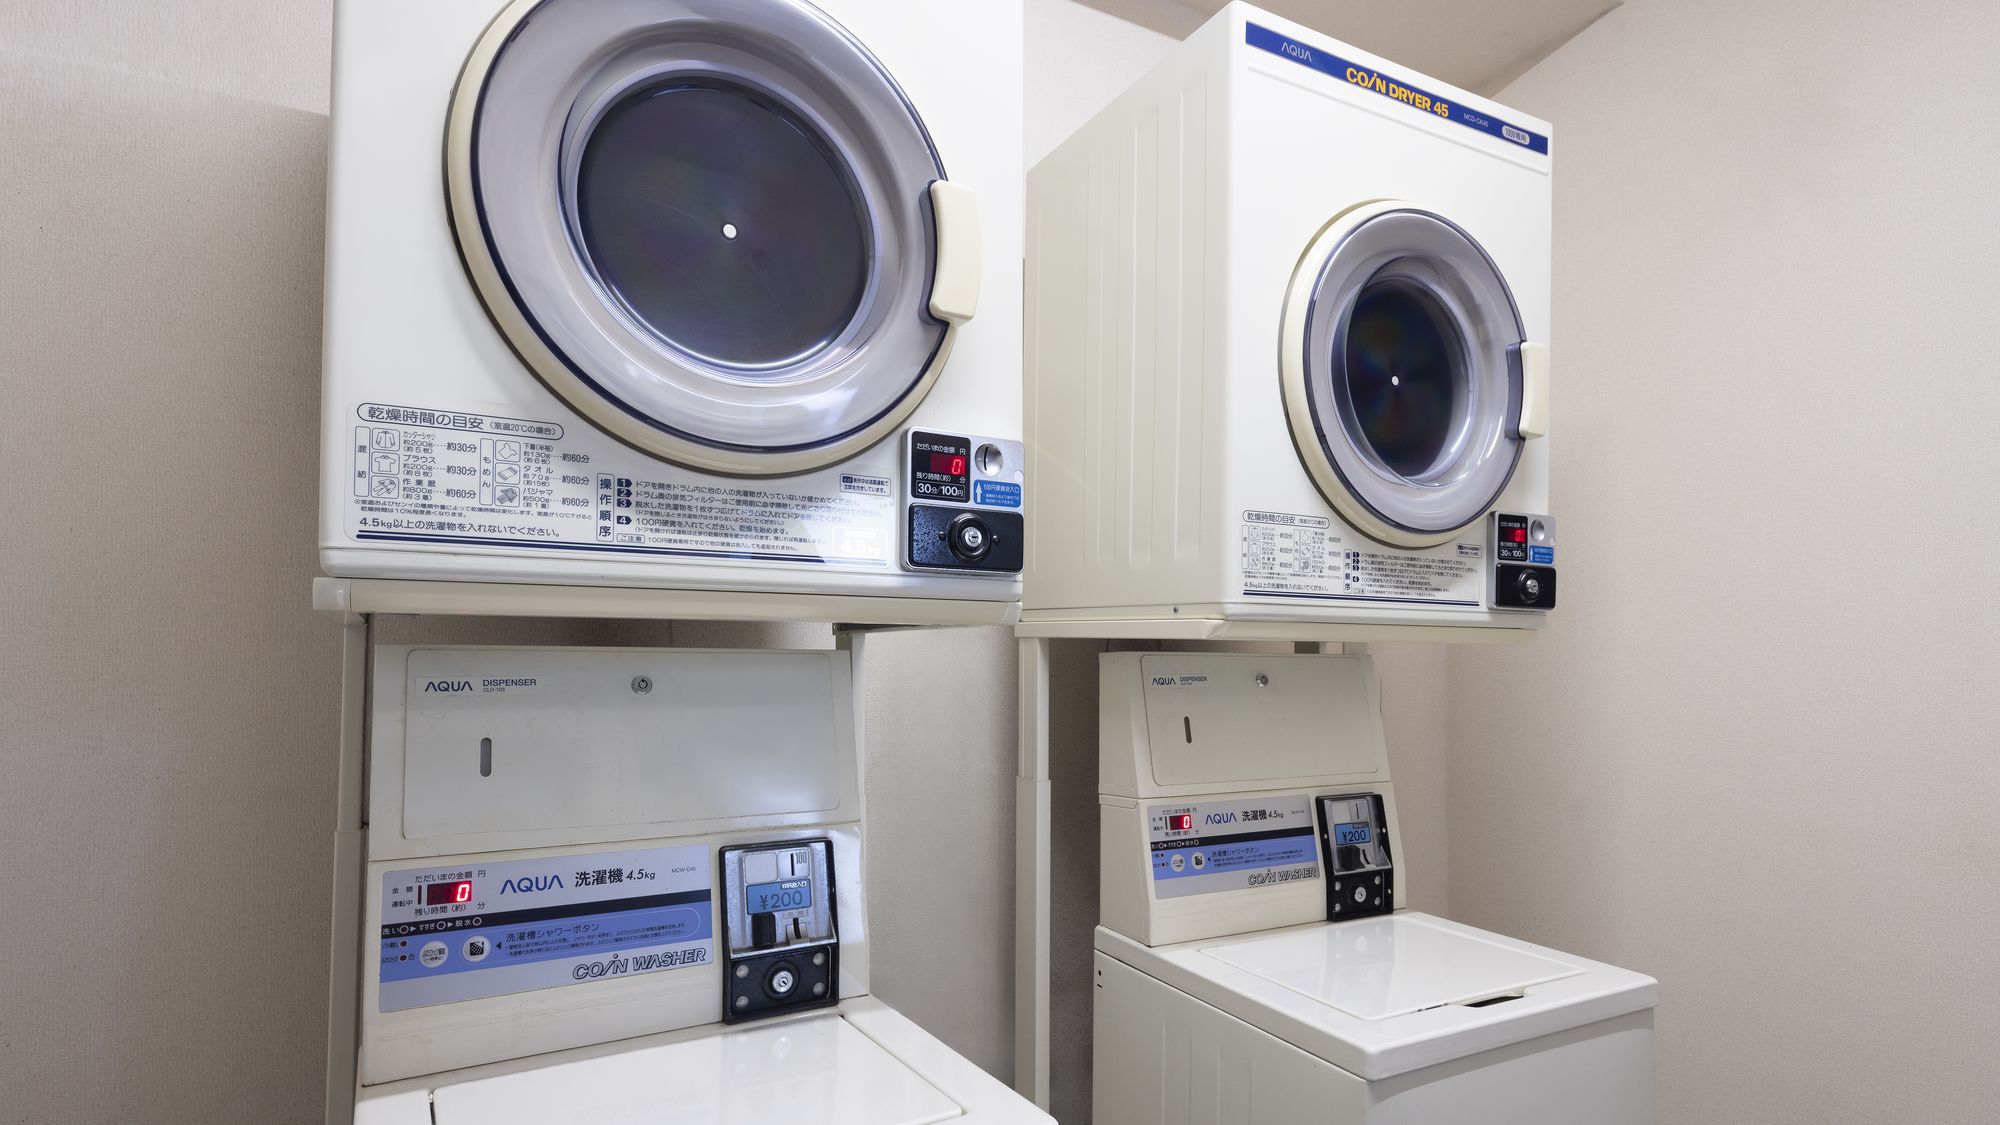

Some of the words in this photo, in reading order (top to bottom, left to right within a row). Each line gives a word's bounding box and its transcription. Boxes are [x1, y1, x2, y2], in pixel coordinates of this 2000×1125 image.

[1281, 42, 1312, 62] AQUA
[1389, 83, 1431, 111] DRYER
[1433, 102, 1449, 117] 45
[368, 406, 484, 430] 乾燥時間の目安
[446, 441, 477, 453] 約30分
[403, 454, 437, 464] ブラウス
[562, 453, 590, 464] 約60分
[446, 465, 477, 476] 約30分
[482, 456, 491, 488] もめん
[523, 465, 554, 474] タオル
[951, 459, 961, 475] 0
[561, 475, 590, 485] 約60分
[960, 476, 966, 484] 分
[446, 488, 477, 499] 約60分
[561, 497, 590, 507] 約60分
[599, 478, 612, 537] 操作順序
[360, 517, 560, 538] 4.5kg以上の洗濯物を入れないでください。
[425, 680, 473, 692] AQUA
[482, 679, 537, 687] DISPENSER
[1152, 677, 1176, 685] AQUA
[1183, 816, 1190, 828] 0
[1205, 812, 1237, 825] AQUA
[1342, 830, 1366, 843] ¥200
[795, 852, 808, 865] 100
[415, 870, 473, 883] ただいまの金額
[477, 869, 486, 878] 円
[1278, 867, 1317, 882] WASHER
[500, 874, 564, 895] AQUA
[575, 868, 624, 888] 洗濯機
[625, 869, 656, 881] 4.5kg
[456, 883, 470, 902] 0
[760, 890, 803, 910] ¥200
[414, 905, 448, 916] 残り時間
[451, 903, 467, 913] (約)
[477, 901, 486, 910] 分
[455, 918, 472, 927] 脱水
[506, 923, 600, 942] 洗濯槽シャワーボタン
[633, 947, 706, 972] WASHER
